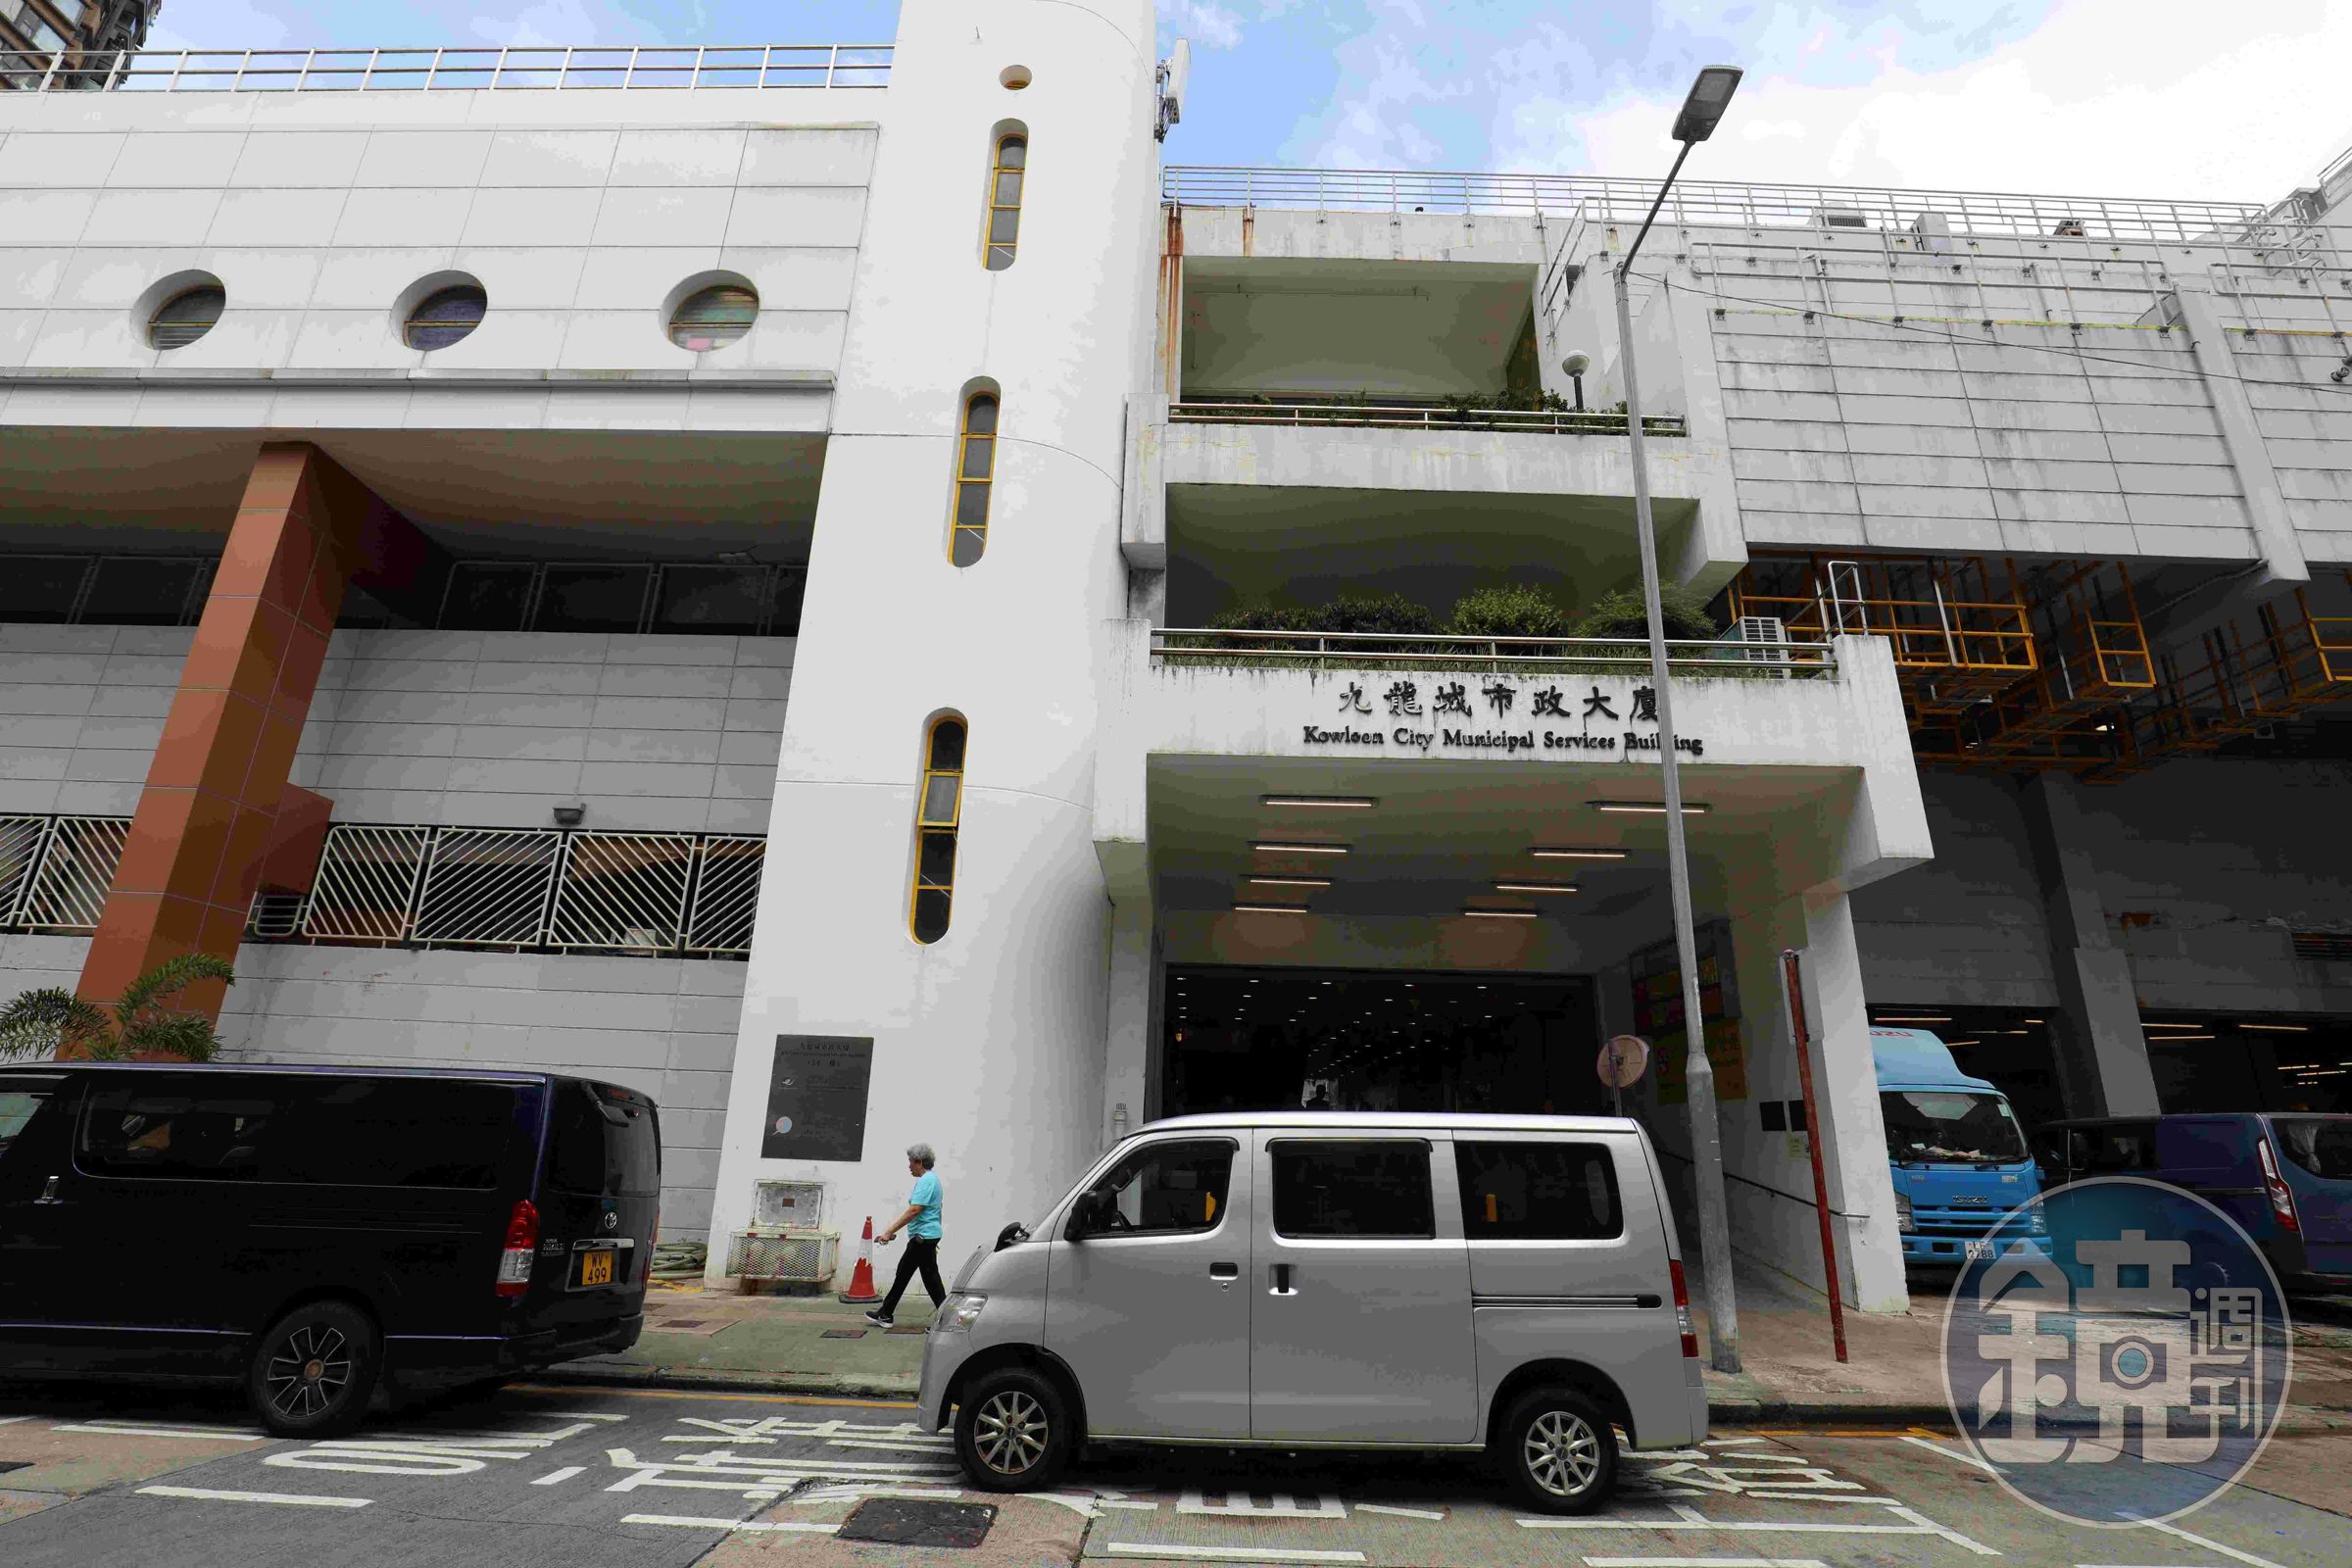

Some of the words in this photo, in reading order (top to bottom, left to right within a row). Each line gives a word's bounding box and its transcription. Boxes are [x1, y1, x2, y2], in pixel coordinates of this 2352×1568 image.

[1339, 680, 1659, 721] 九龍城市政大廈
[1303, 725, 1384, 744] Kowloon
[1393, 727, 1434, 752] City
[1443, 729, 1535, 753] Municipal
[1544, 730, 1615, 749] Services
[1623, 731, 1703, 756] Builing
[591, 1253, 604, 1267] WV
[588, 1267, 607, 1283] 499
